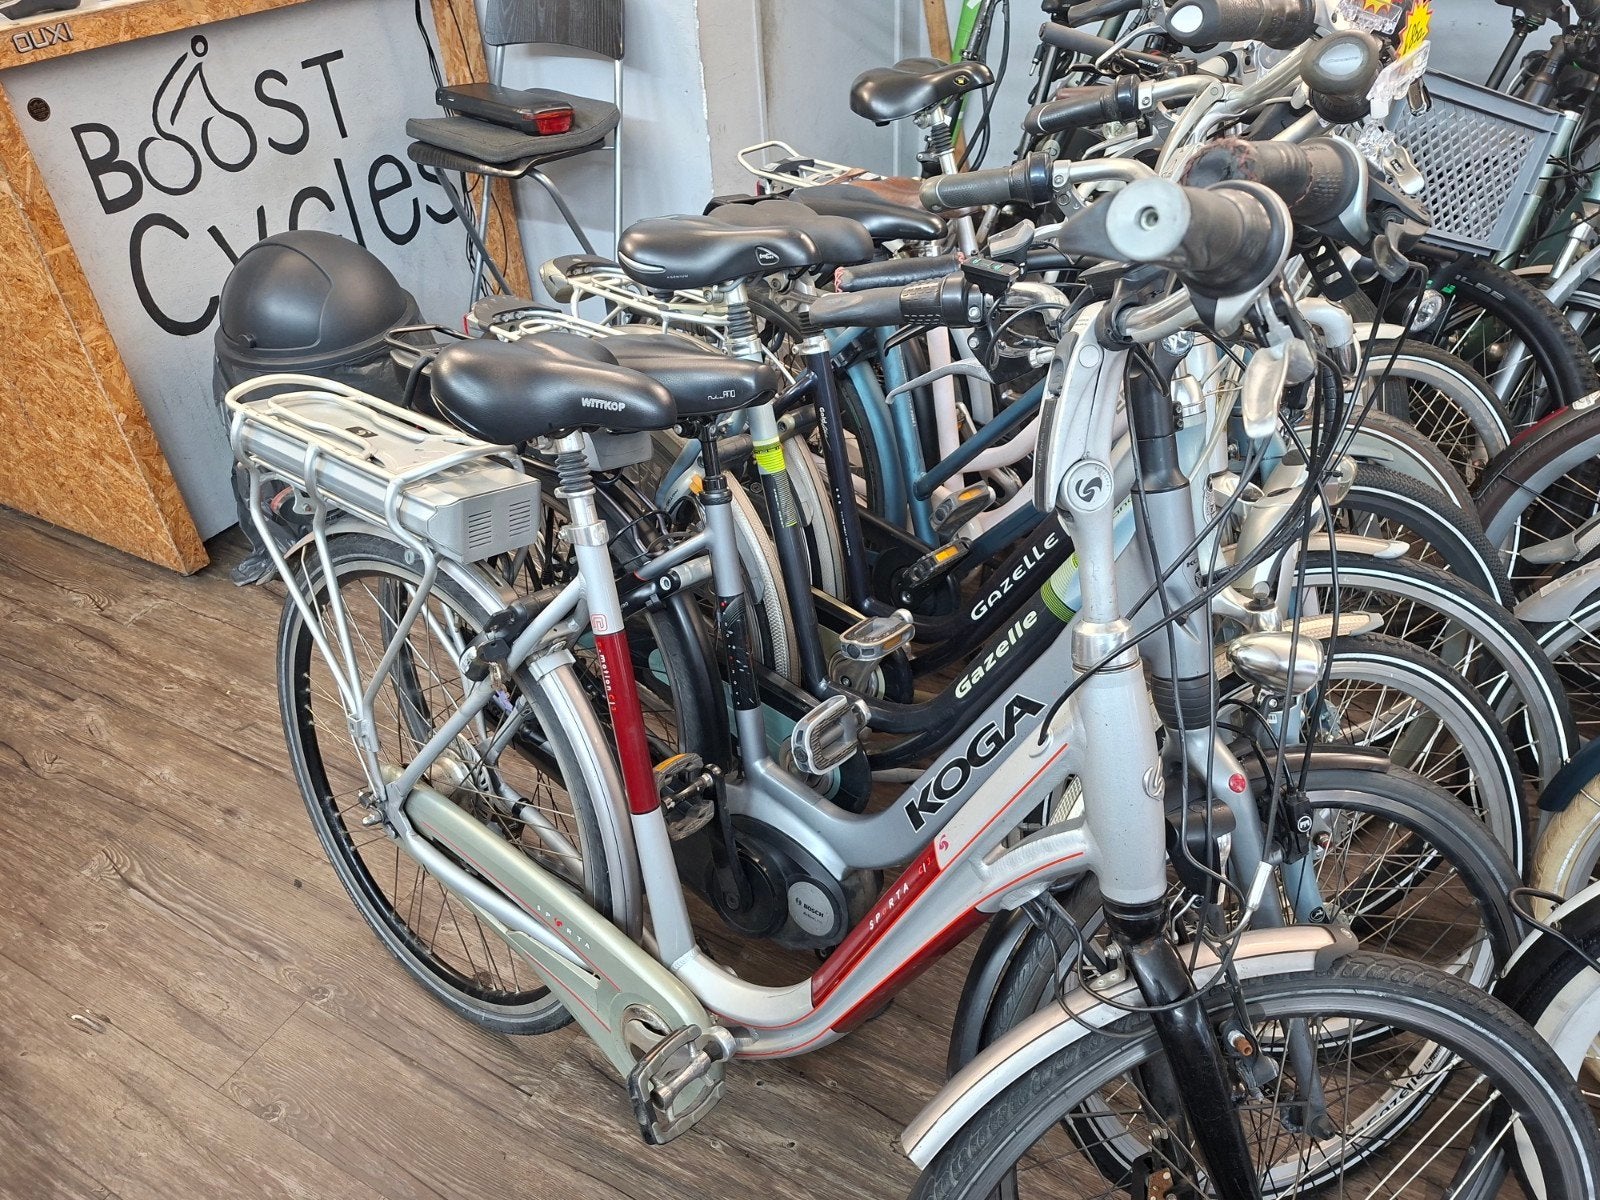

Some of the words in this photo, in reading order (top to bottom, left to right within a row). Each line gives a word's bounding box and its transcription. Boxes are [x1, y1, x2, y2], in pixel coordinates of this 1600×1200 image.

[12, 22, 74, 53] OUXI
[581, 397, 625, 412] WITTKOP
[971, 531, 1059, 621] GAZELLE
[955, 610, 1038, 699] Gazelle
[903, 692, 1048, 834] KOGA
[803, 903, 824, 918] BOSCH
